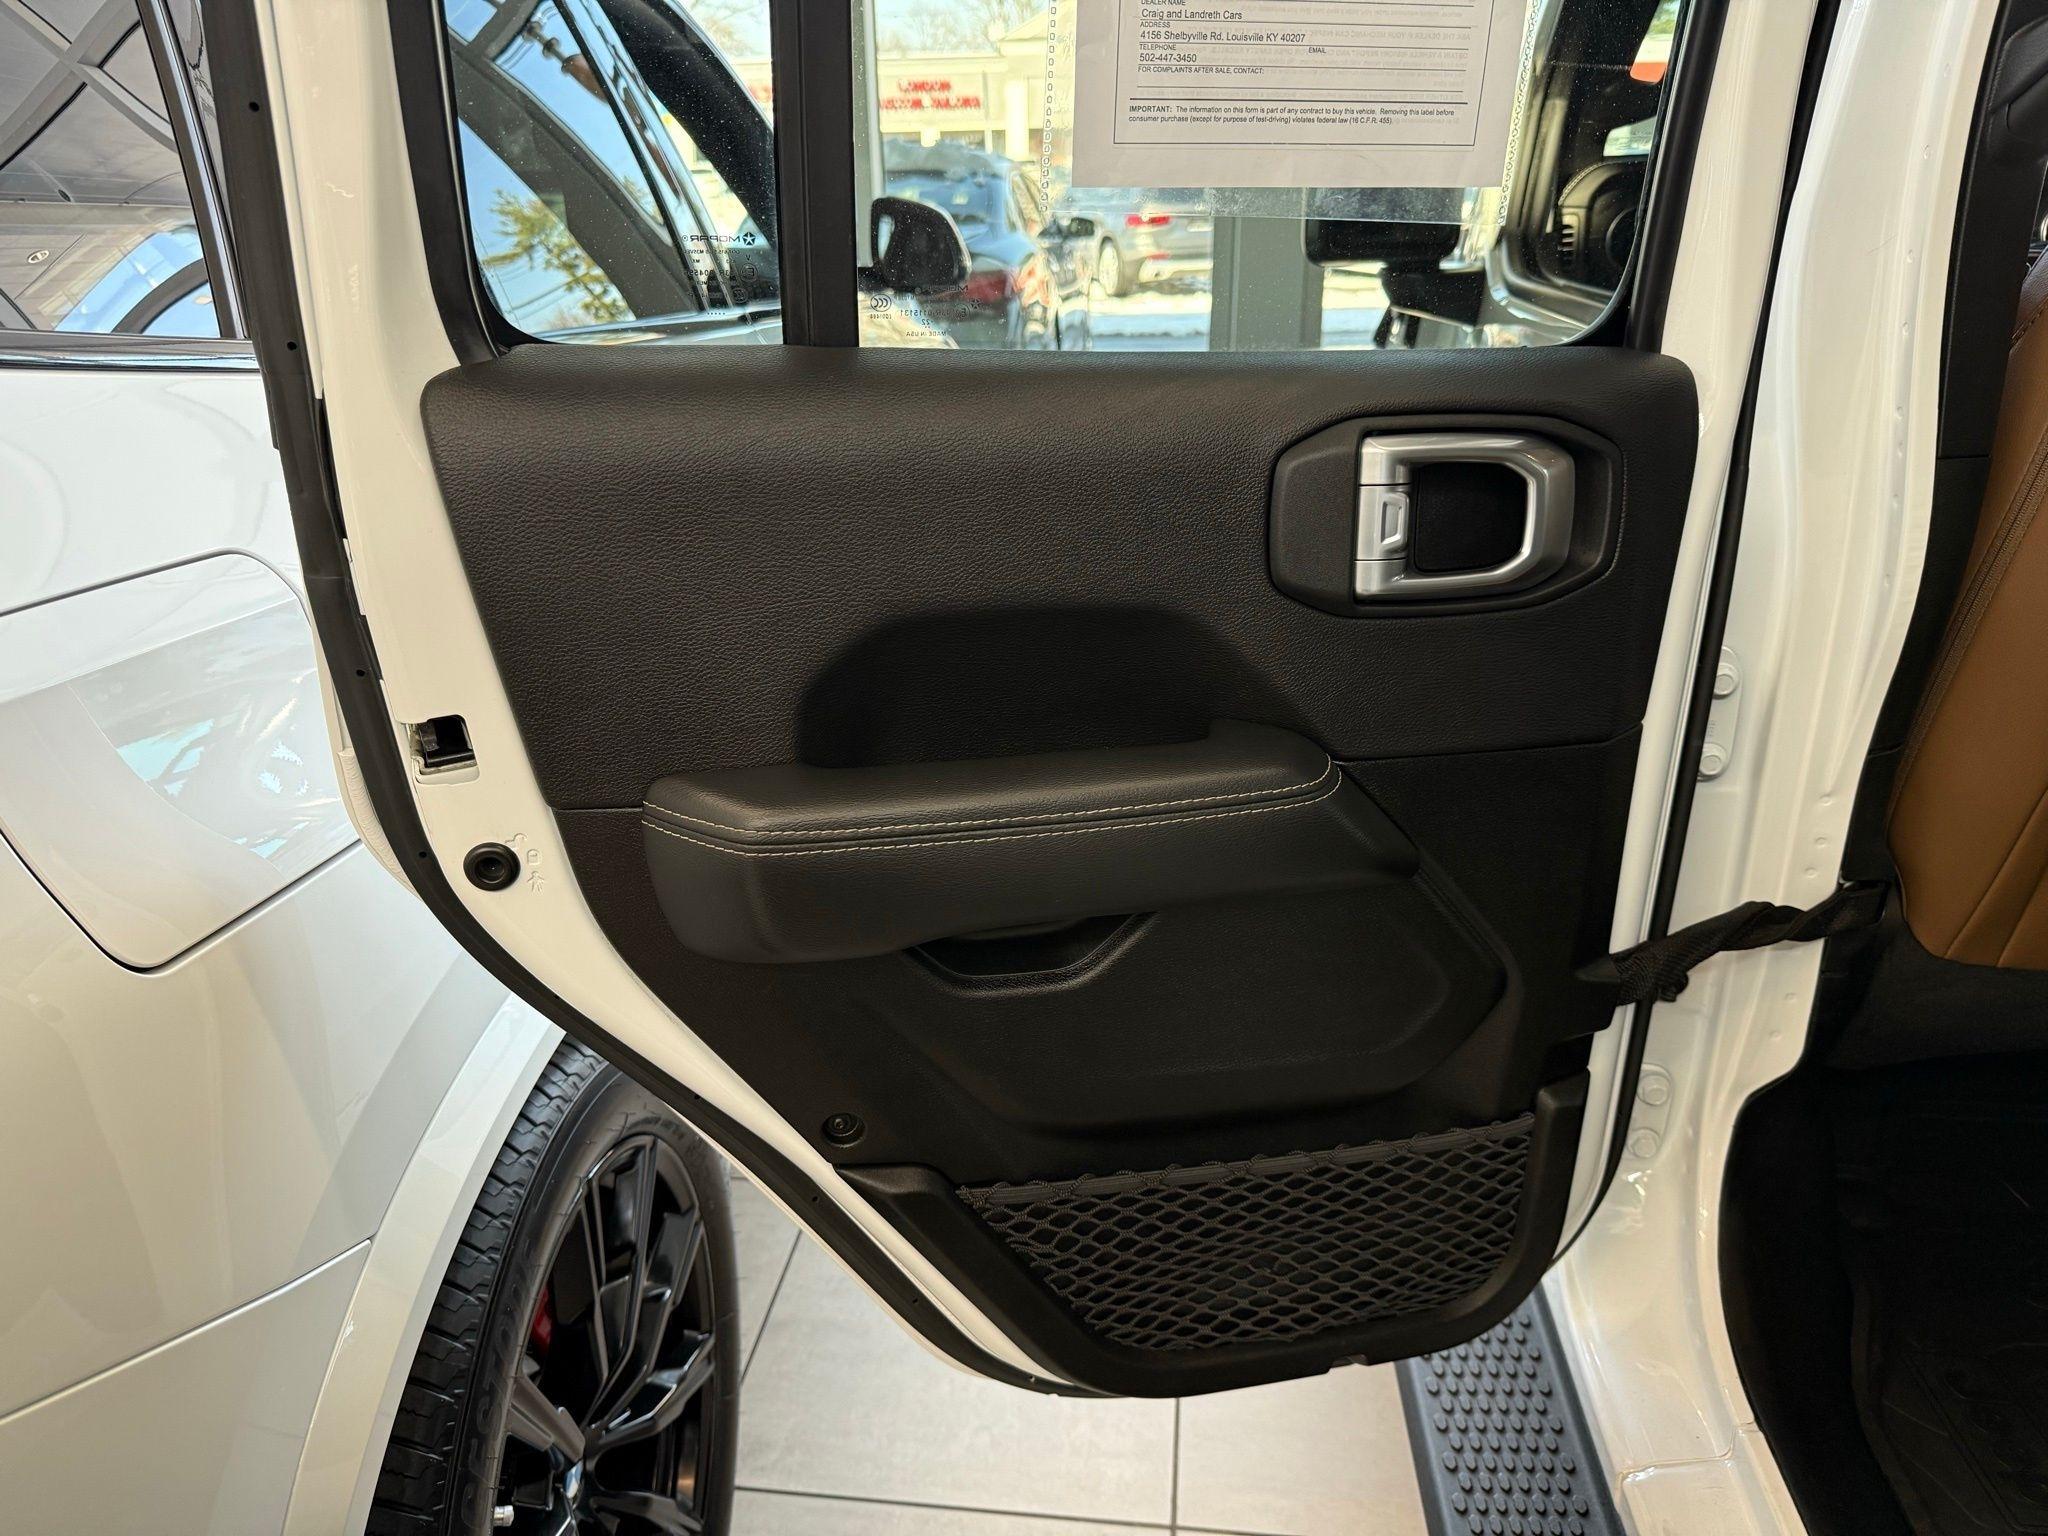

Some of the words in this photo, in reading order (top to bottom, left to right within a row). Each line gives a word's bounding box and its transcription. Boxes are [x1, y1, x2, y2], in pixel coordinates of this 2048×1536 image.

[1141, 8, 1164, 20] Craig
[1166, 10, 1182, 19] and
[1184, 9, 1221, 19] Landreth
[1222, 10, 1243, 20] Cars
[1140, 30, 1162, 40] 4156
[1163, 31, 1208, 42] Shelbyville
[1209, 32, 1224, 41] Rd.
[1226, 32, 1264, 42] Louisville
[1266, 33, 1279, 42] KY
[1280, 33, 1306, 43] 40207
[1139, 43, 1177, 51] TELEPHONE
[1308, 46, 1327, 54] EMAIL
[1139, 53, 1197, 63] 502-447-3450
[1129, 105, 1172, 113] IMPORTANT:
[1176, 105, 1188, 113] The
[1266, 107, 1278, 115] part
[1300, 107, 1324, 115] contract
[1332, 107, 1343, 116] buy
[1380, 108, 1408, 116] Removing
[1160, 115, 1189, 123] purchase
[1190, 115, 1212, 123] (except
[1223, 116, 1247, 124] purpose
[1292, 116, 1315, 124] violates
[1316, 116, 1338, 124] federal
